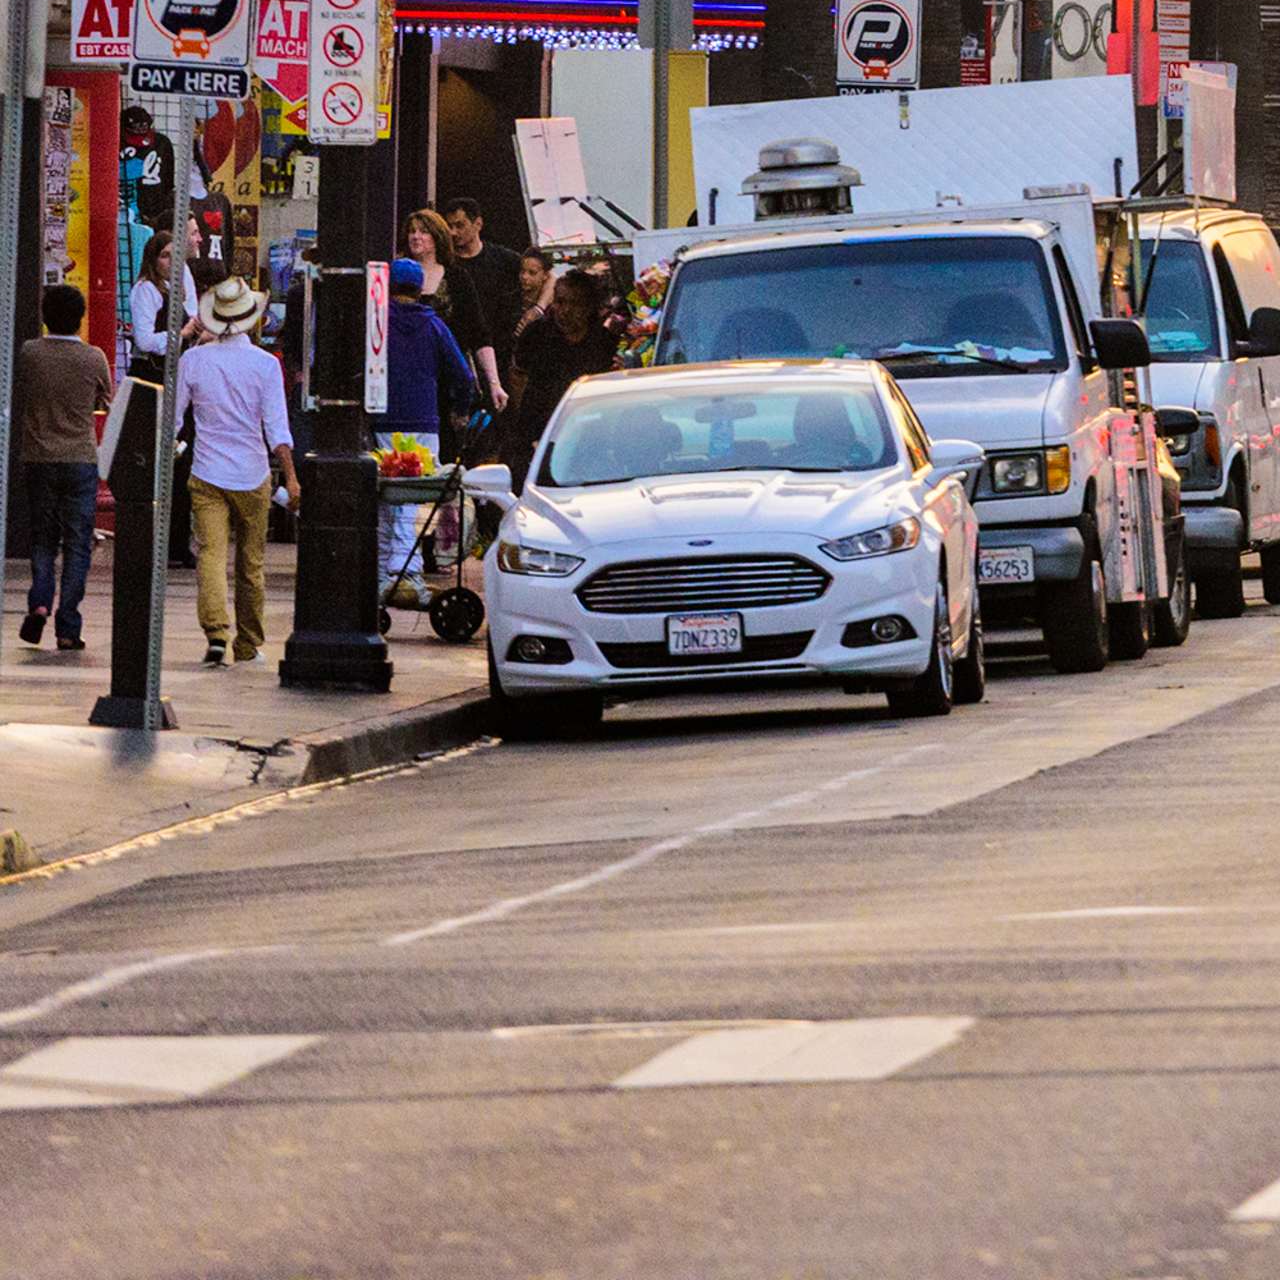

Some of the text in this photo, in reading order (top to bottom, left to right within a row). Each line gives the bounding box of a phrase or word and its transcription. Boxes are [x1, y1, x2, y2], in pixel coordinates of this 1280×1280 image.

[259, 0, 309, 38] AT
[79, 43, 104, 57] EBT
[259, 40, 308, 57] MACH
[138, 67, 241, 94] PAY HERE
